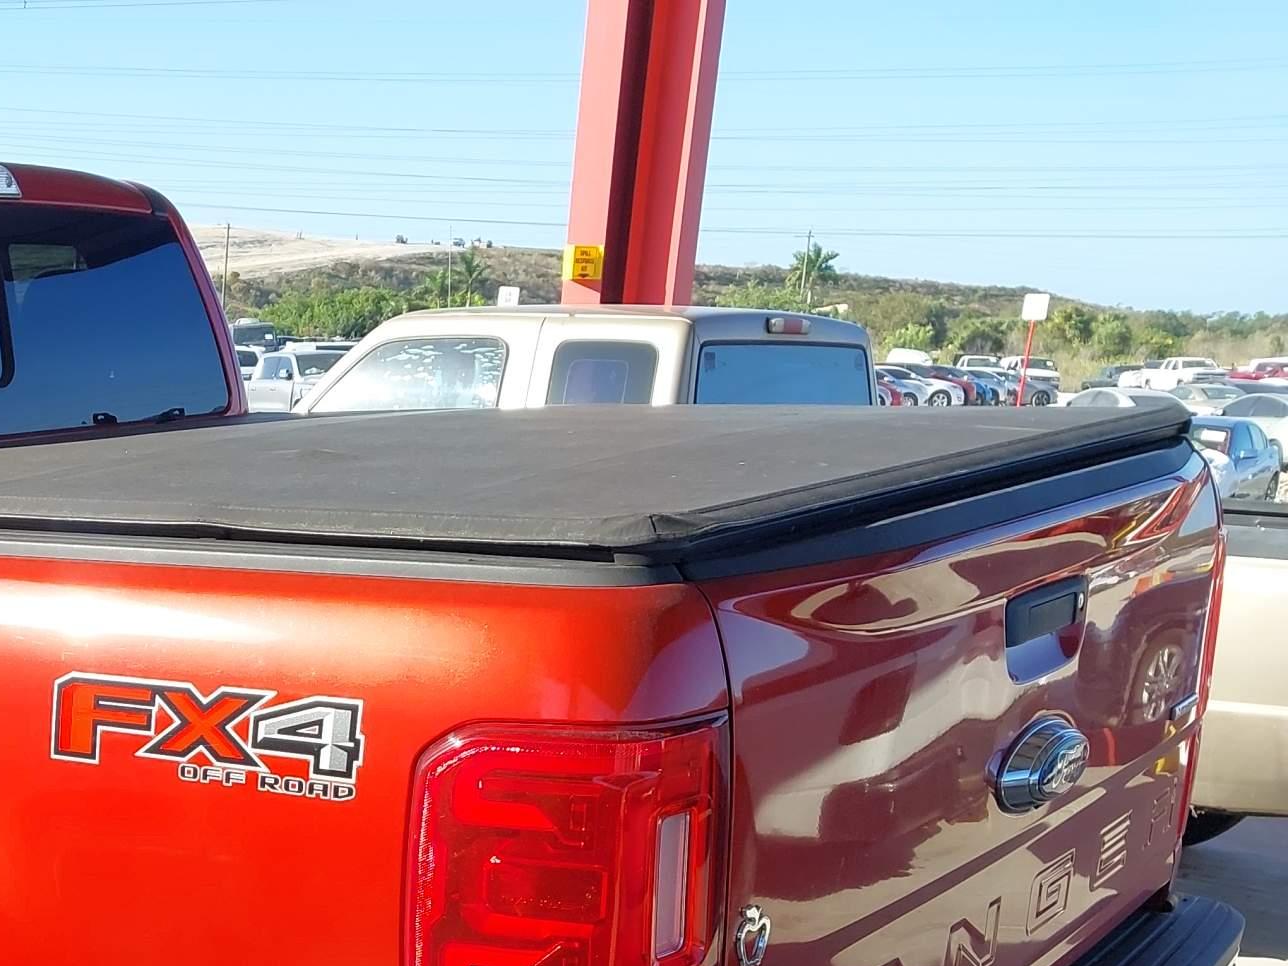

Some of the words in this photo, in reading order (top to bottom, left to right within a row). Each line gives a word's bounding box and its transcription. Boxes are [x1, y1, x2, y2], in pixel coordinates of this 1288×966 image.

[51, 670, 366, 784] FX4
[177, 763, 247, 787] OFF
[257, 771, 357, 801] ROAD
